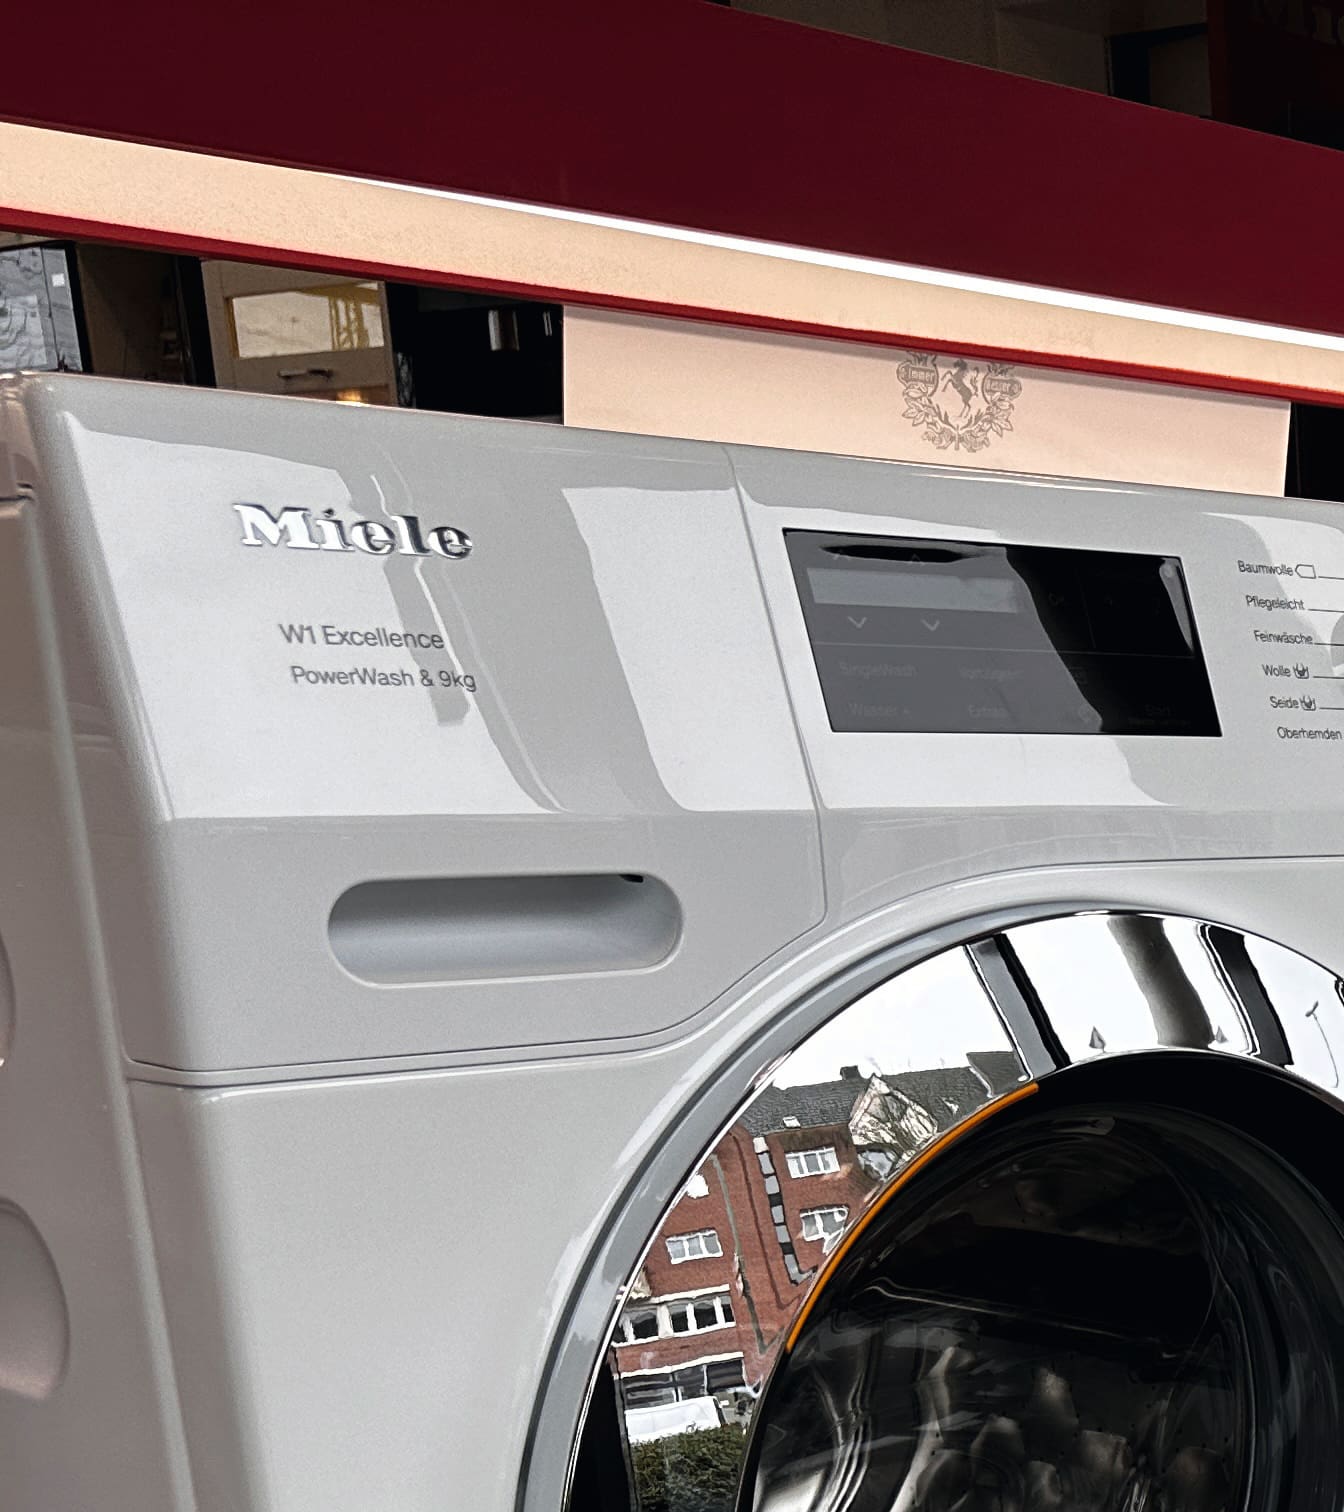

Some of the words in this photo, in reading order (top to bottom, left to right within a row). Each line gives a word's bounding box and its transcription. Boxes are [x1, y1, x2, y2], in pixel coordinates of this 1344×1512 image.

[233, 503, 473, 560] Miele
[1238, 560, 1293, 576] Baumwolle
[1246, 595, 1305, 611] Pflegeleicht
[279, 624, 316, 645] W1
[321, 625, 445, 649] Excellence
[1254, 630, 1313, 644] Feinwäsche
[291, 665, 414, 687] PowerWash
[420, 669, 433, 687] &
[439, 671, 477, 692] 9kg
[1262, 664, 1291, 677] Wolle
[1270, 696, 1299, 709] Seide
[1277, 726, 1343, 740] Oberhemden
